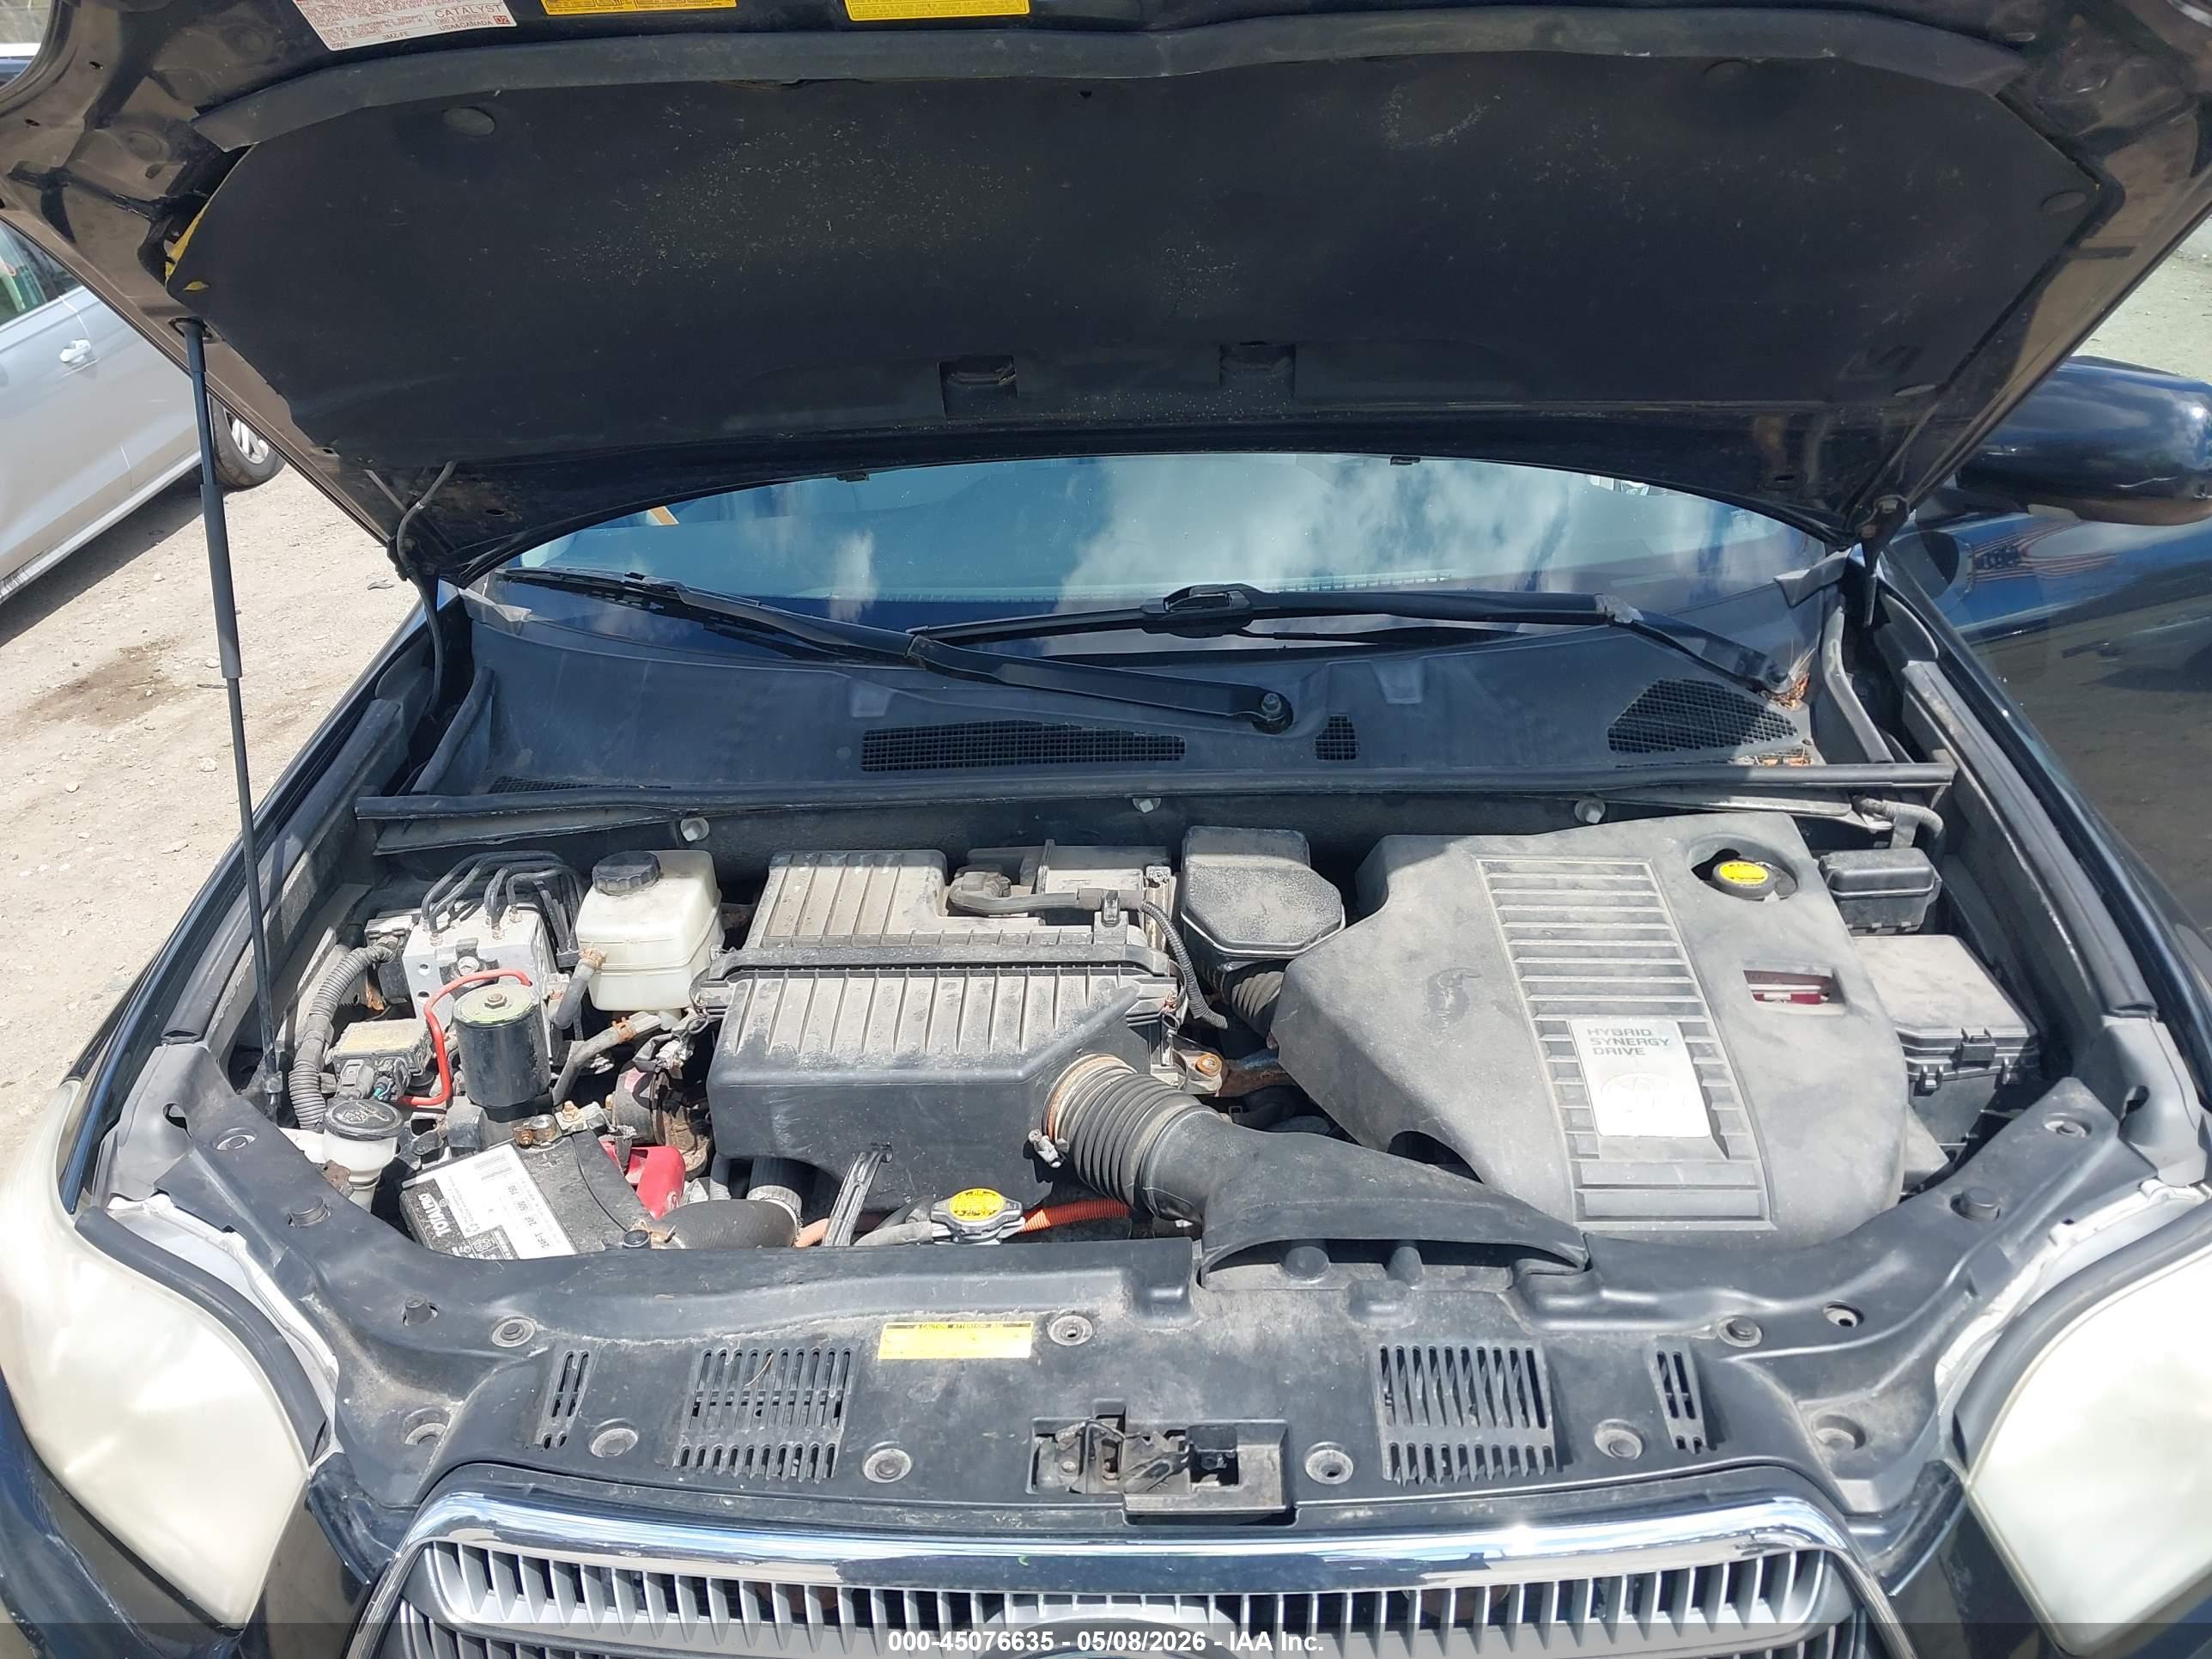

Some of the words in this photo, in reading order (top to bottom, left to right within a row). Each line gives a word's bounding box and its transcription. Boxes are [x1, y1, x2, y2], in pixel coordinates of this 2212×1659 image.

[434, 3, 502, 18] CATALYST
[495, 15, 509, 25] D2
[439, 20, 494, 31] USA&CANADA
[382, 31, 410, 40] 3MZ-FE
[1587, 1028, 1652, 1036] HYBRID
[1590, 1037, 1669, 1046] SYNERGY
[1593, 1047, 1646, 1055] DRIVE
